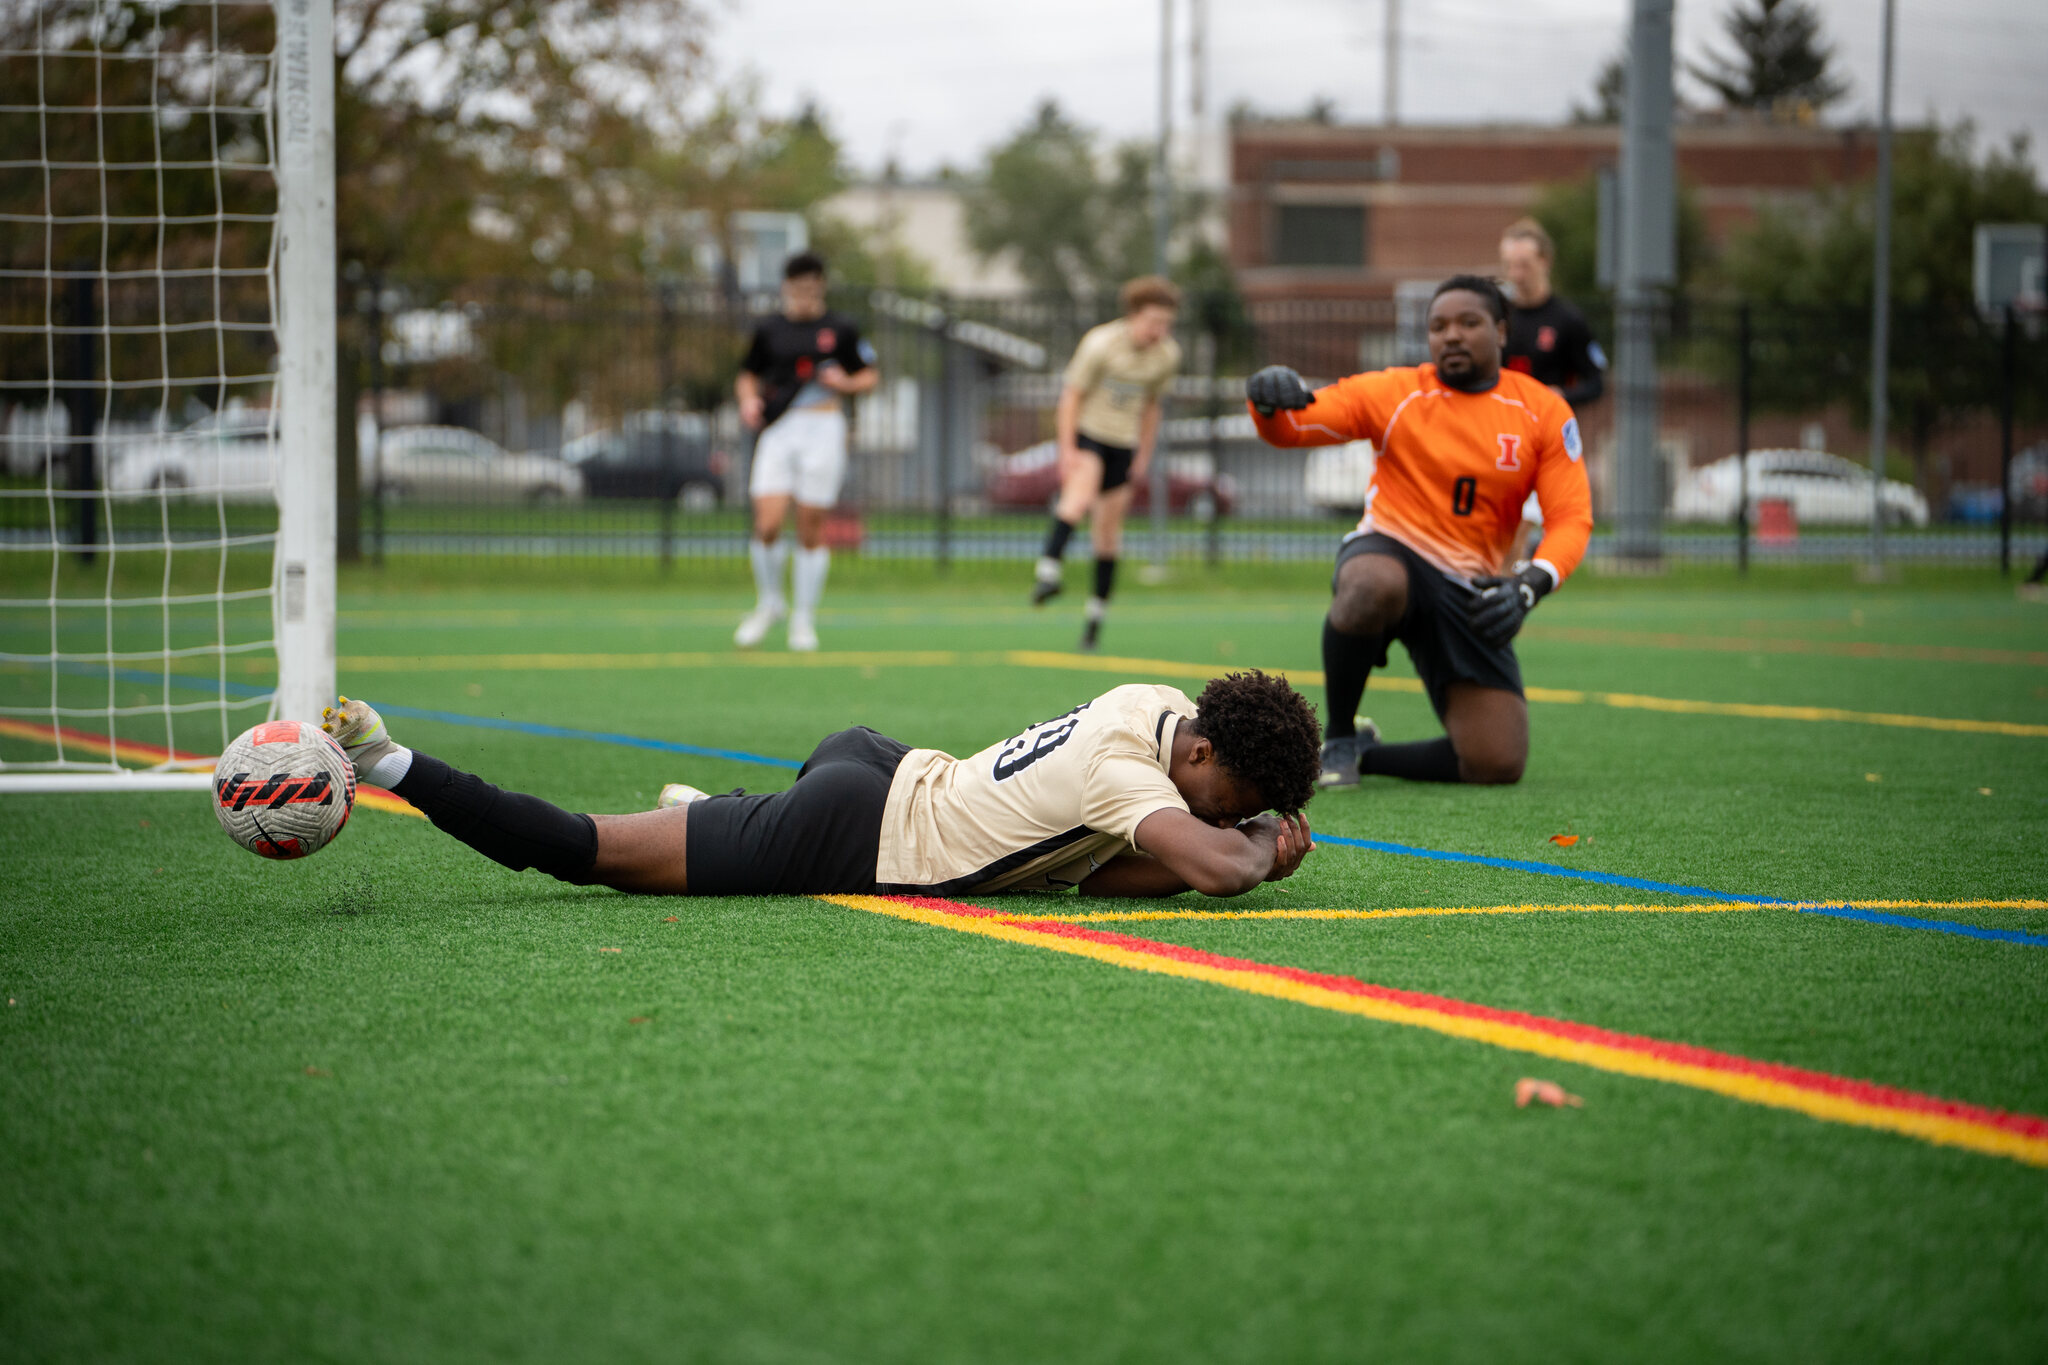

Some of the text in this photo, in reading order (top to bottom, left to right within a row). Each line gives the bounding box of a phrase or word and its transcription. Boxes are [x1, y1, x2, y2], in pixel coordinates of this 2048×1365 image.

[1496, 434, 1520, 471] I
[1453, 476, 1476, 516] 0
[993, 700, 1092, 782] 9
